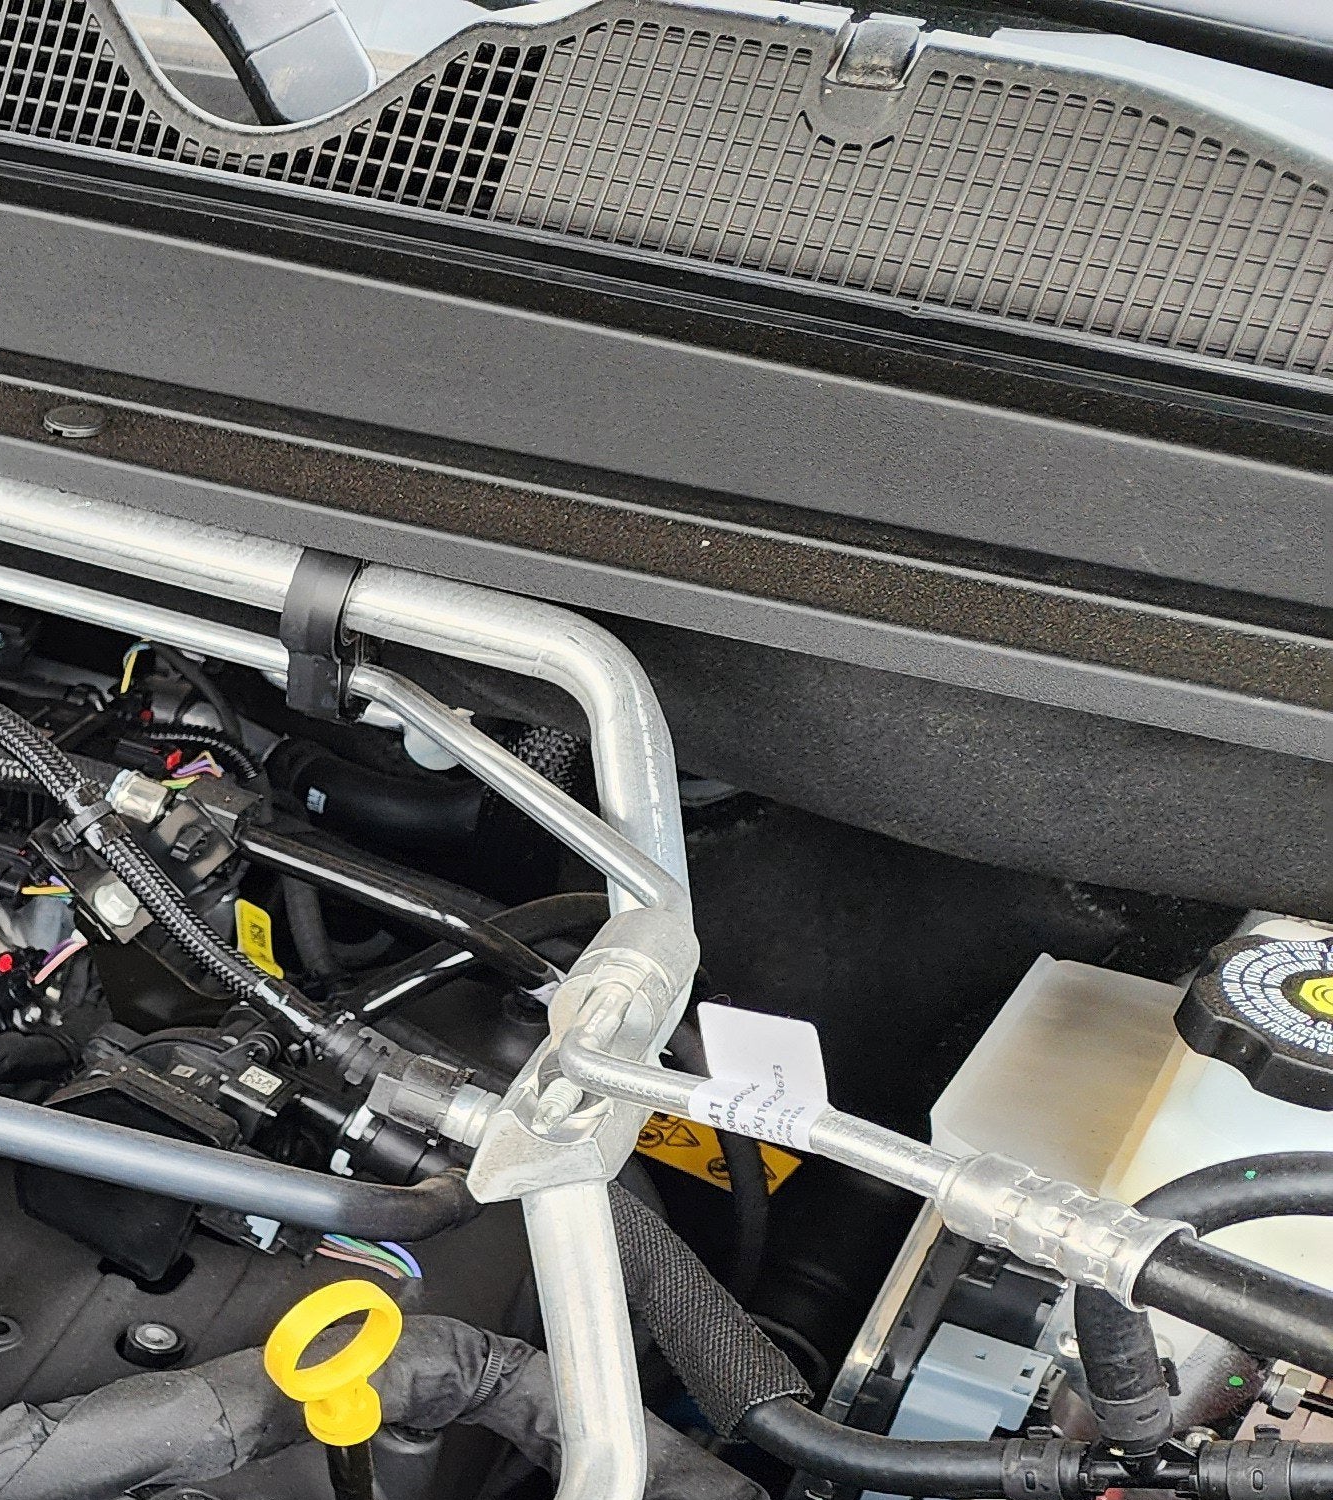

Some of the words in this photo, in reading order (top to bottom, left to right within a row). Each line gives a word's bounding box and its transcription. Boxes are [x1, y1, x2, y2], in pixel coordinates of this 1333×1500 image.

[1259, 941, 1329, 955] NETTOYER
[1293, 950, 1324, 961] QUE
[1233, 1000, 1271, 1025] FLUID
[1262, 1021, 1308, 1045] FROM
[1302, 1039, 1317, 1051] A
